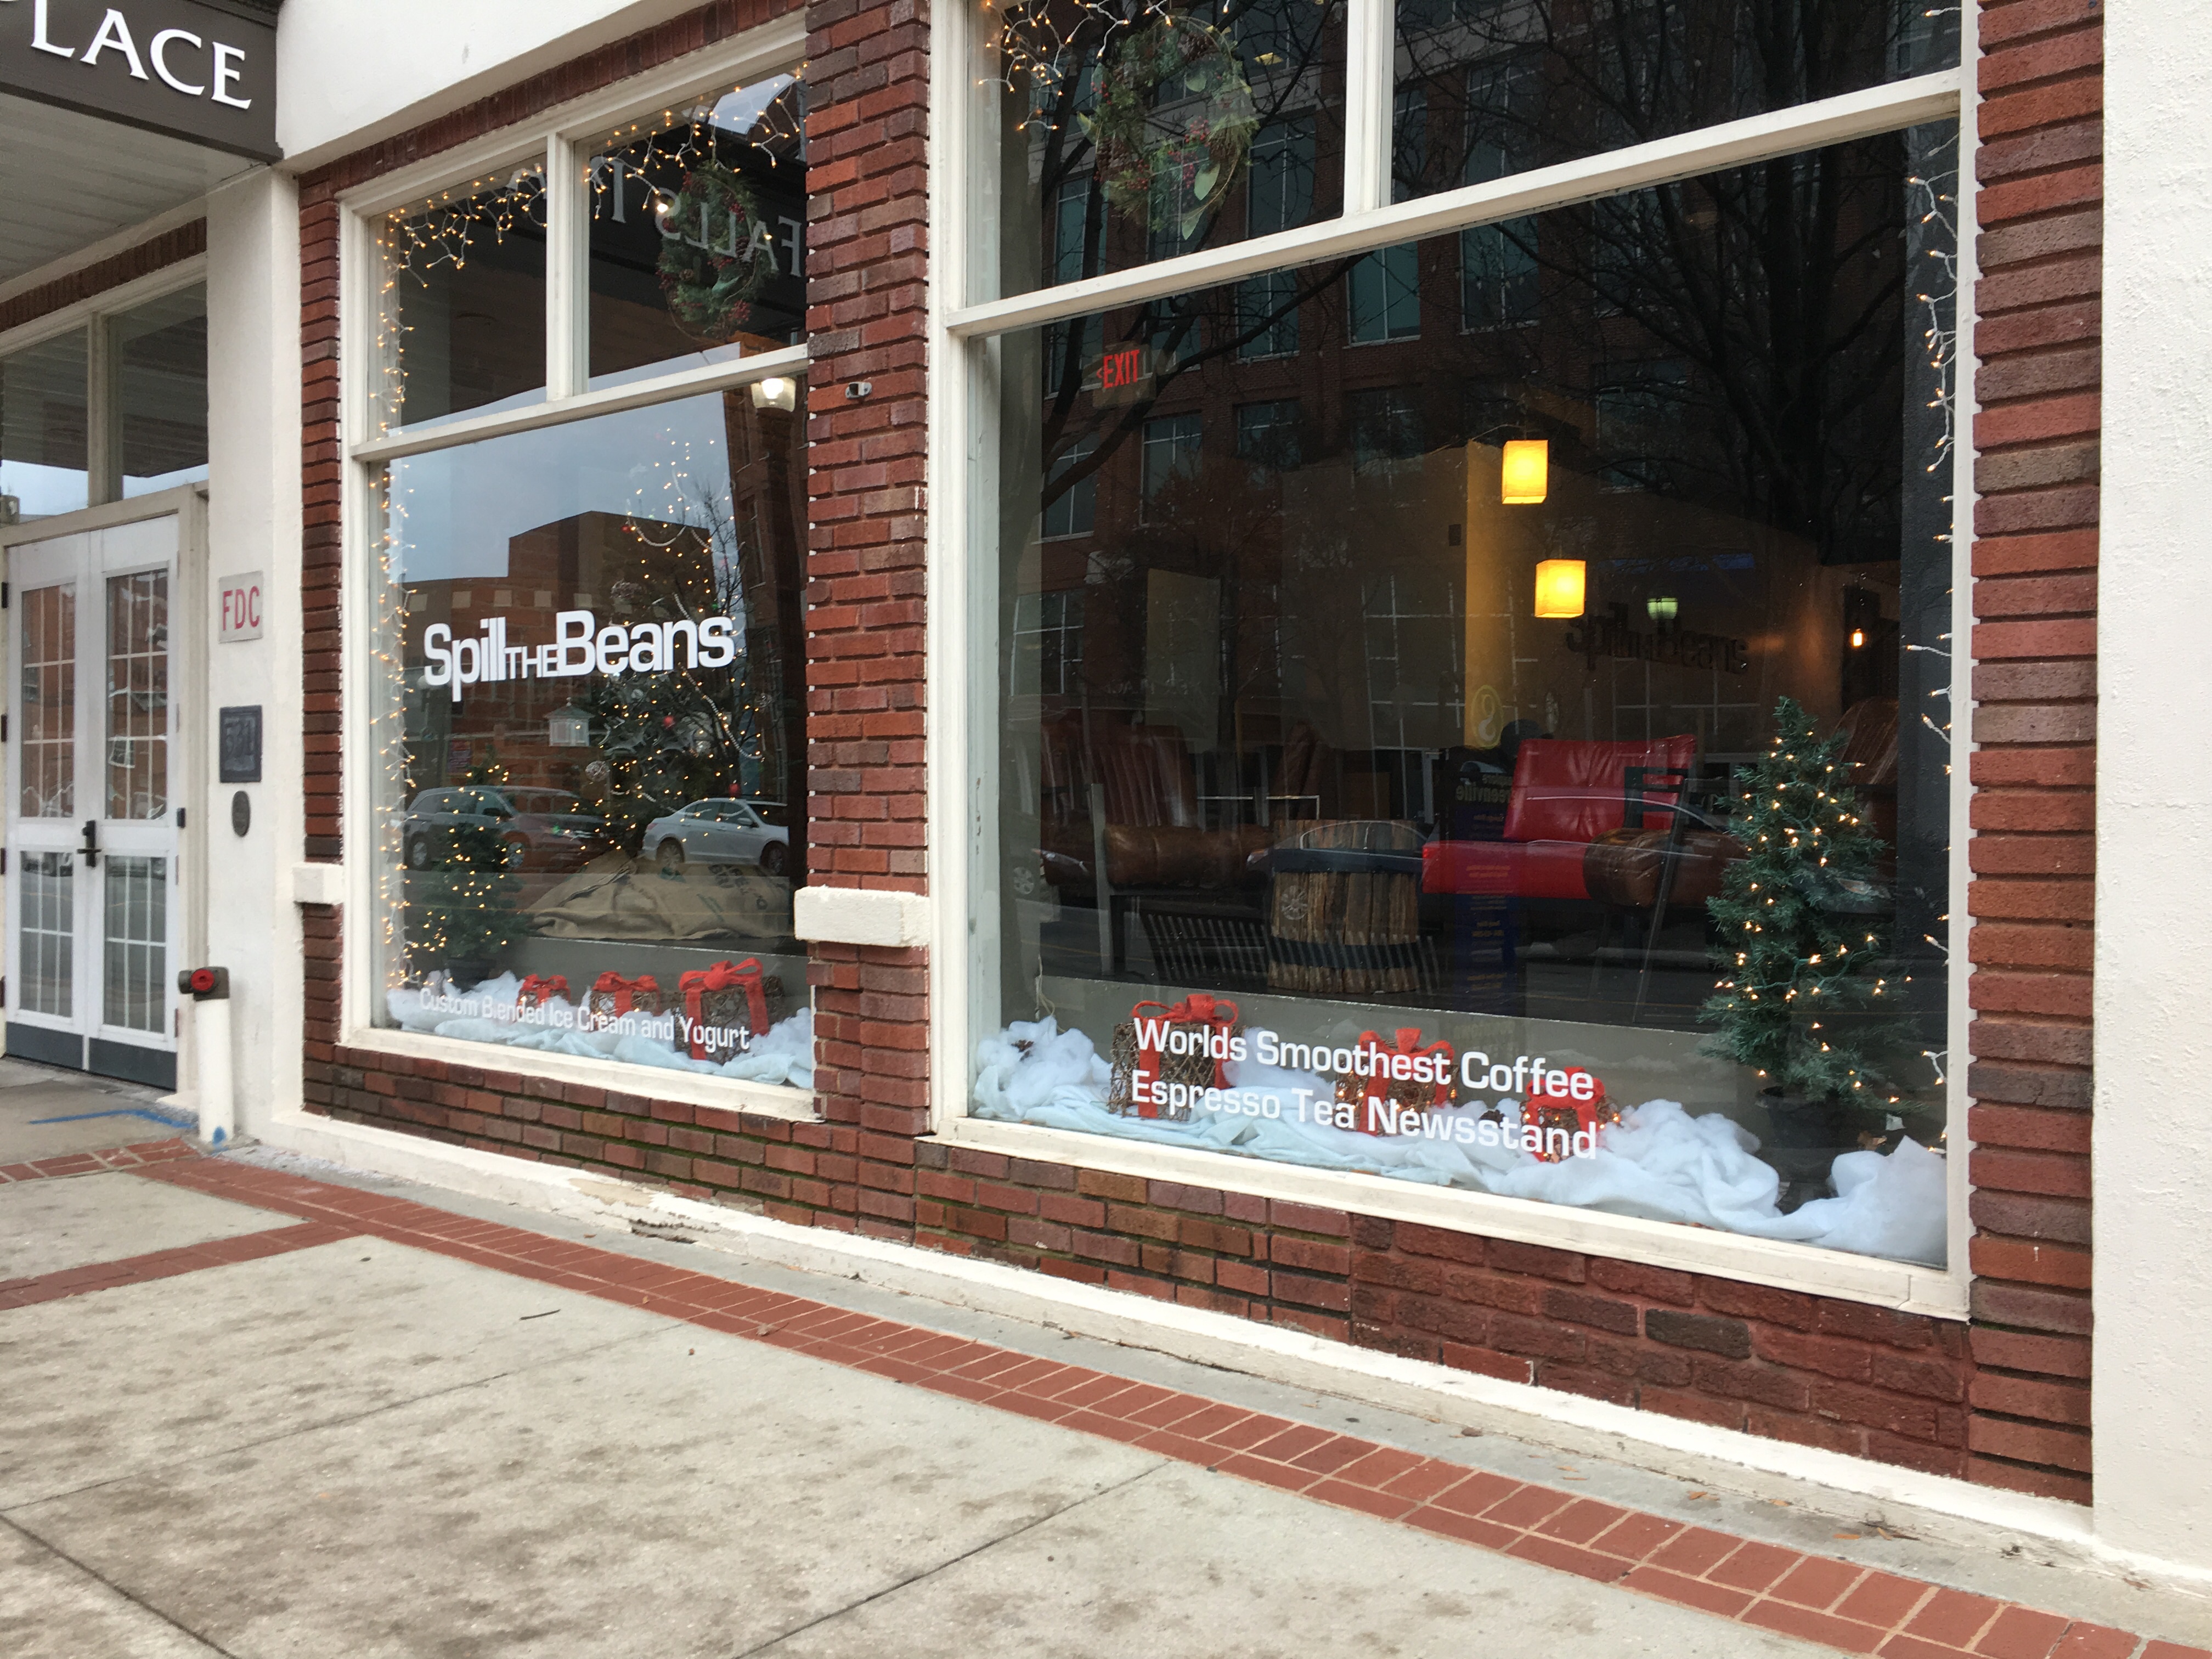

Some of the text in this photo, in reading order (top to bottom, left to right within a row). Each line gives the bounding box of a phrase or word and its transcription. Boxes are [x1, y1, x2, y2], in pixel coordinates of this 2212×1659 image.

[31, 0, 252, 109] LACE
[1103, 349, 1139, 388] EXIT
[222, 586, 261, 632] FDC
[420, 988, 478, 1016] Custom
[549, 1002, 574, 1029] Ice
[577, 1006, 636, 1035] Cream
[641, 1015, 675, 1041] and
[677, 1014, 750, 1053] Yogurt
[1134, 1017, 1594, 1100] Worlds Smoothest Coffee
[1132, 1069, 1596, 1159] Espresso Tea Newsstand
